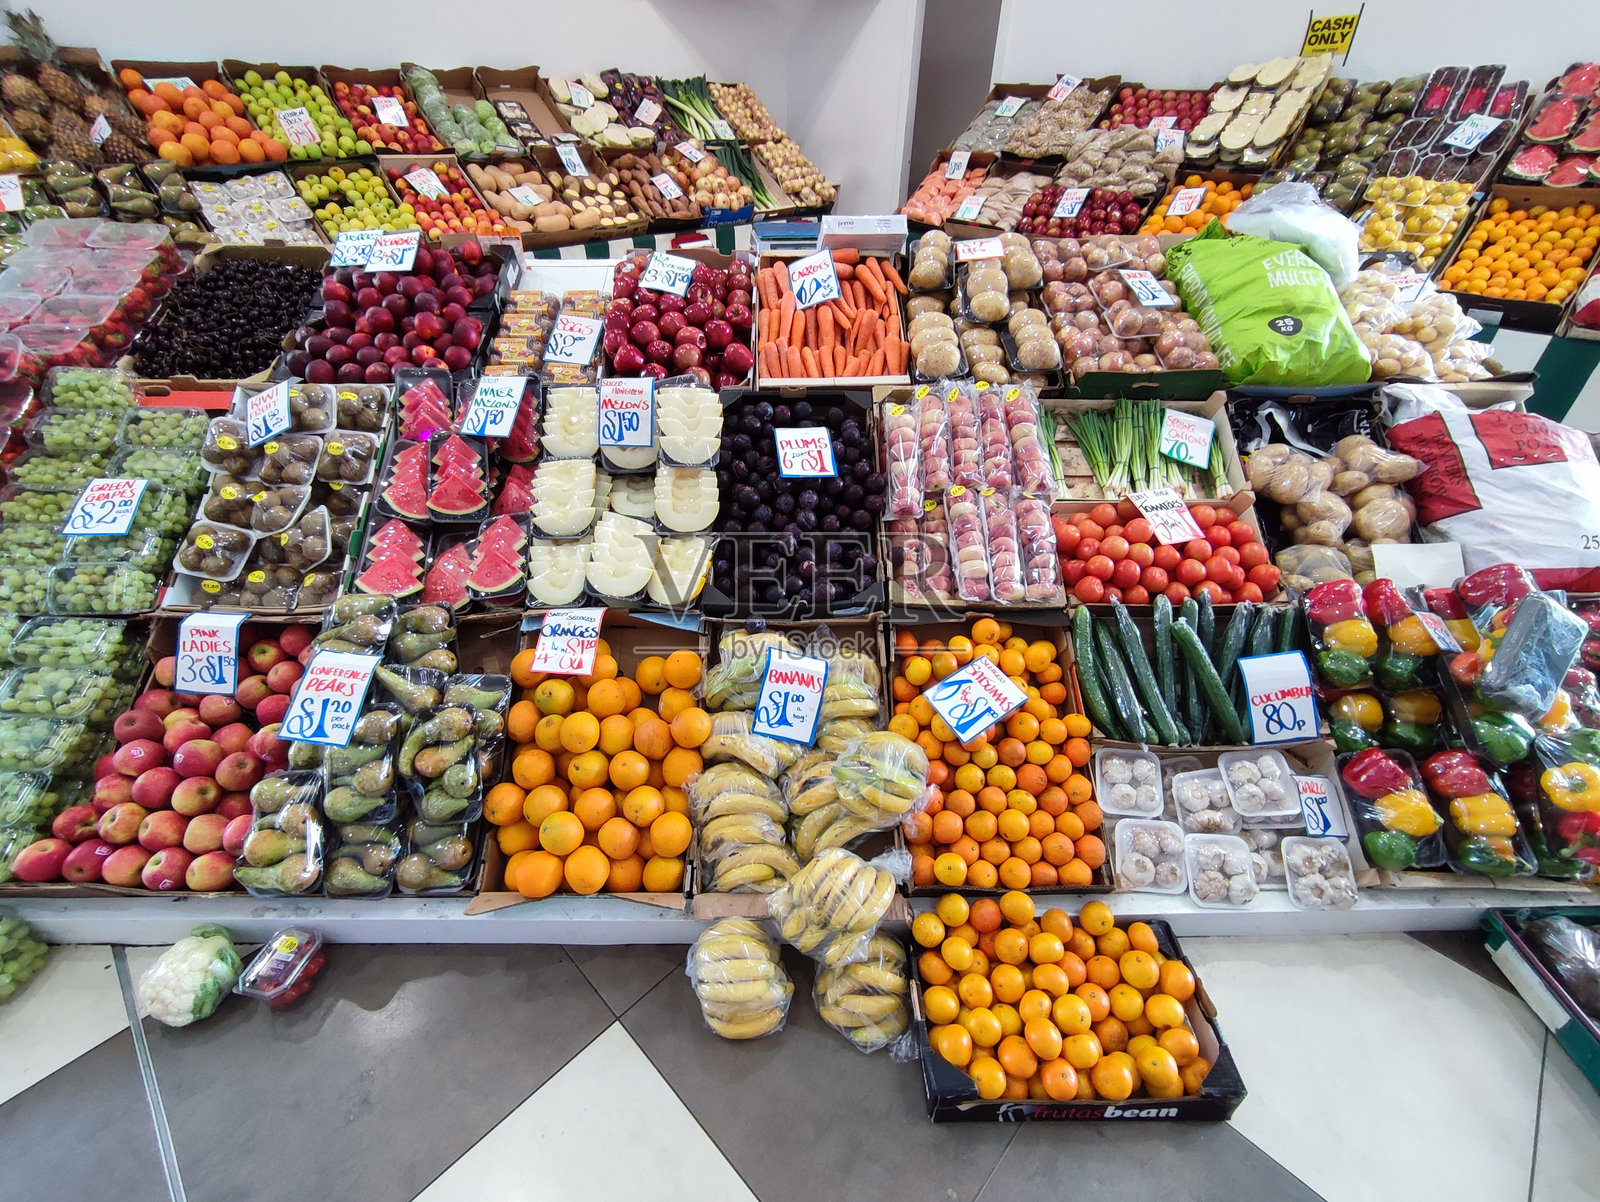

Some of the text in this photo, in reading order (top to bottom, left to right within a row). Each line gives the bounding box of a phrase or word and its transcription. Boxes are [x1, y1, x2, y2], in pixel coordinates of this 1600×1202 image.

[1311, 17, 1356, 32] CASH
[1307, 31, 1352, 46] ONLY
[645, 268, 659, 283] 3
[791, 261, 830, 282] CARROTS
[556, 317, 594, 336] EGGS
[1275, 317, 1295, 327] 25
[250, 386, 279, 412] KIWI
[473, 398, 518, 409] MELONS
[601, 398, 650, 411] MELONS
[249, 399, 278, 422] FRUIT
[779, 437, 828, 451] PLUMS
[782, 451, 794, 470] 6
[89, 480, 136, 495] GREEN
[83, 488, 137, 504] GRAPES
[1580, 534, 1600, 550] 25
[188, 628, 222, 641] PINK
[540, 623, 599, 639] ORANGES
[181, 640, 232, 655] LADIES
[180, 654, 198, 684] 3
[309, 666, 371, 692] CONFERENCE
[768, 668, 824, 694] BANANAS
[304, 678, 356, 698] PEARS
[330, 723, 351, 733] pack
[1298, 780, 1328, 796] GARLIC
